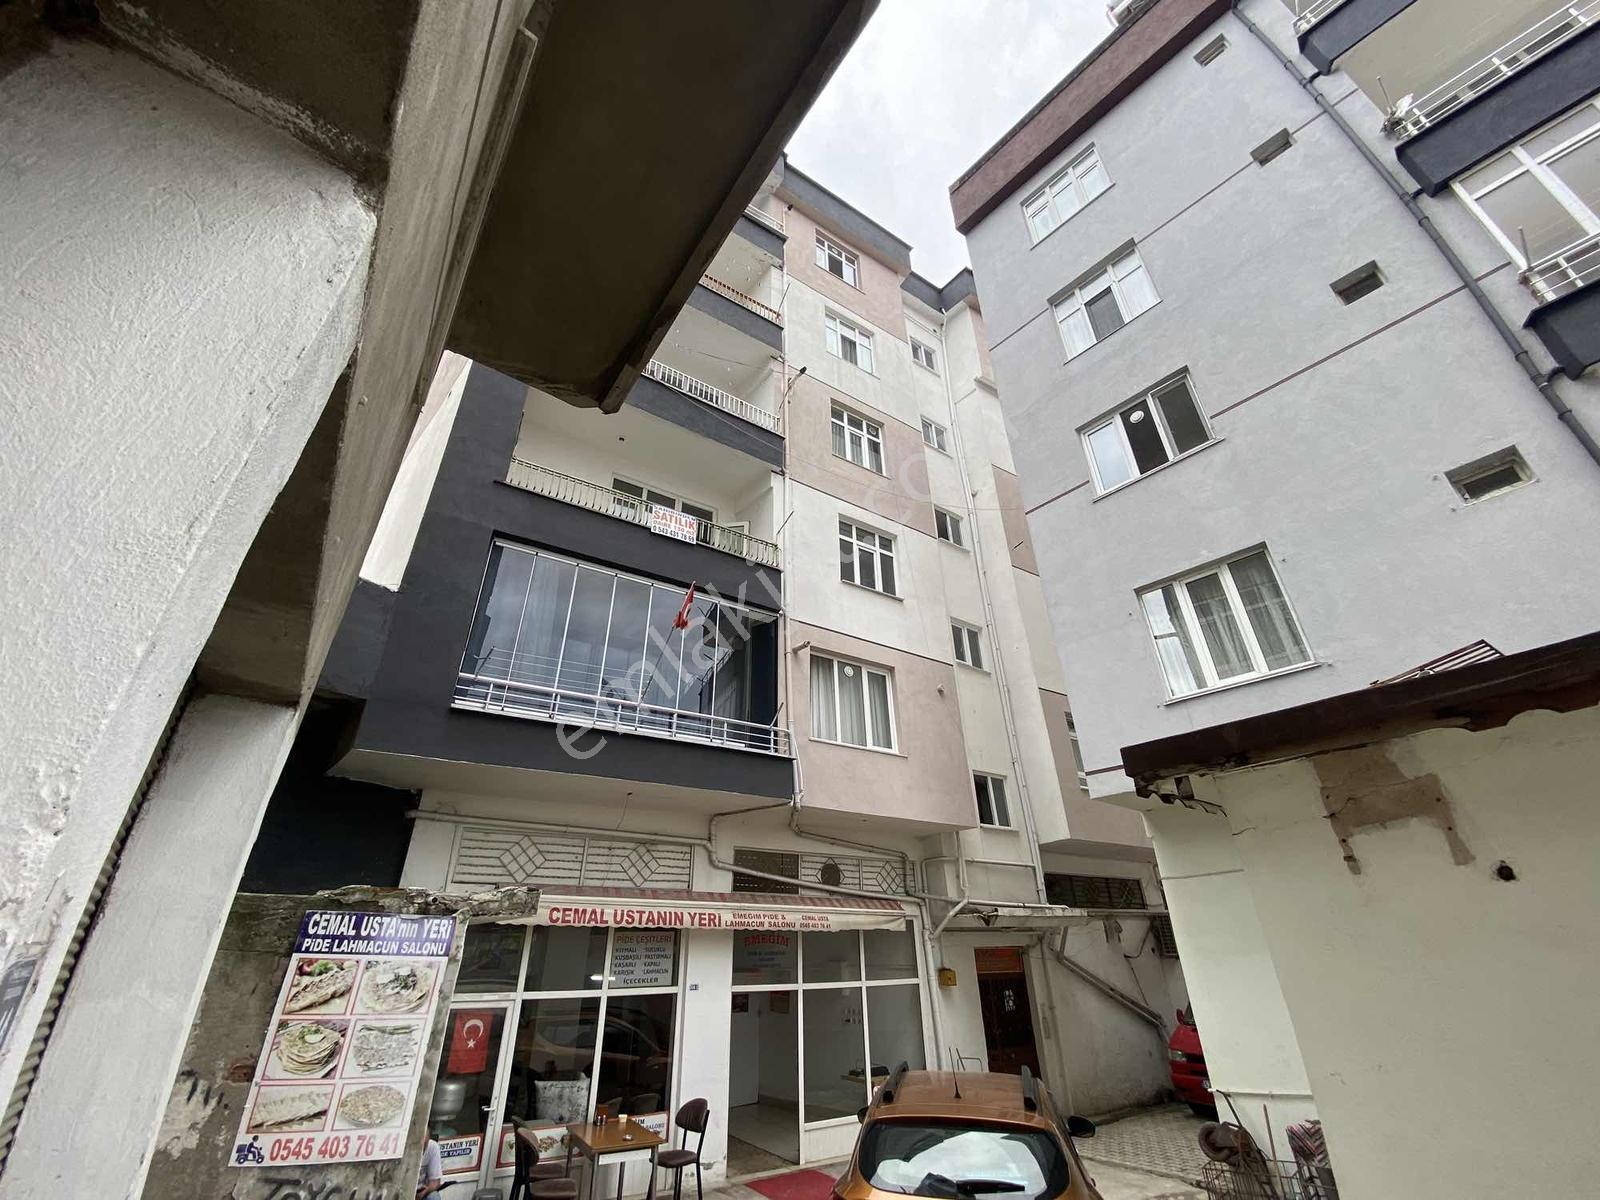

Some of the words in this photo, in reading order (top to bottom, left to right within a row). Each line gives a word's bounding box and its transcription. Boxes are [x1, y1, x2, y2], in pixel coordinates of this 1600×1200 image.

[653, 510, 695, 531] SATILIK
[307, 912, 357, 936] CEMAL
[549, 907, 609, 925] CEMAL
[613, 909, 684, 926] USTANIN
[725, 920, 765, 928] LAHMACUN
[768, 921, 796, 929] SALONU
[332, 939, 401, 953] LAHMACUN
[400, 941, 447, 955] SALONU
[269, 1137, 315, 1161] 0545
[317, 1135, 350, 1159] 403
[354, 1134, 375, 1158] 76
[379, 1133, 400, 1156] 41
